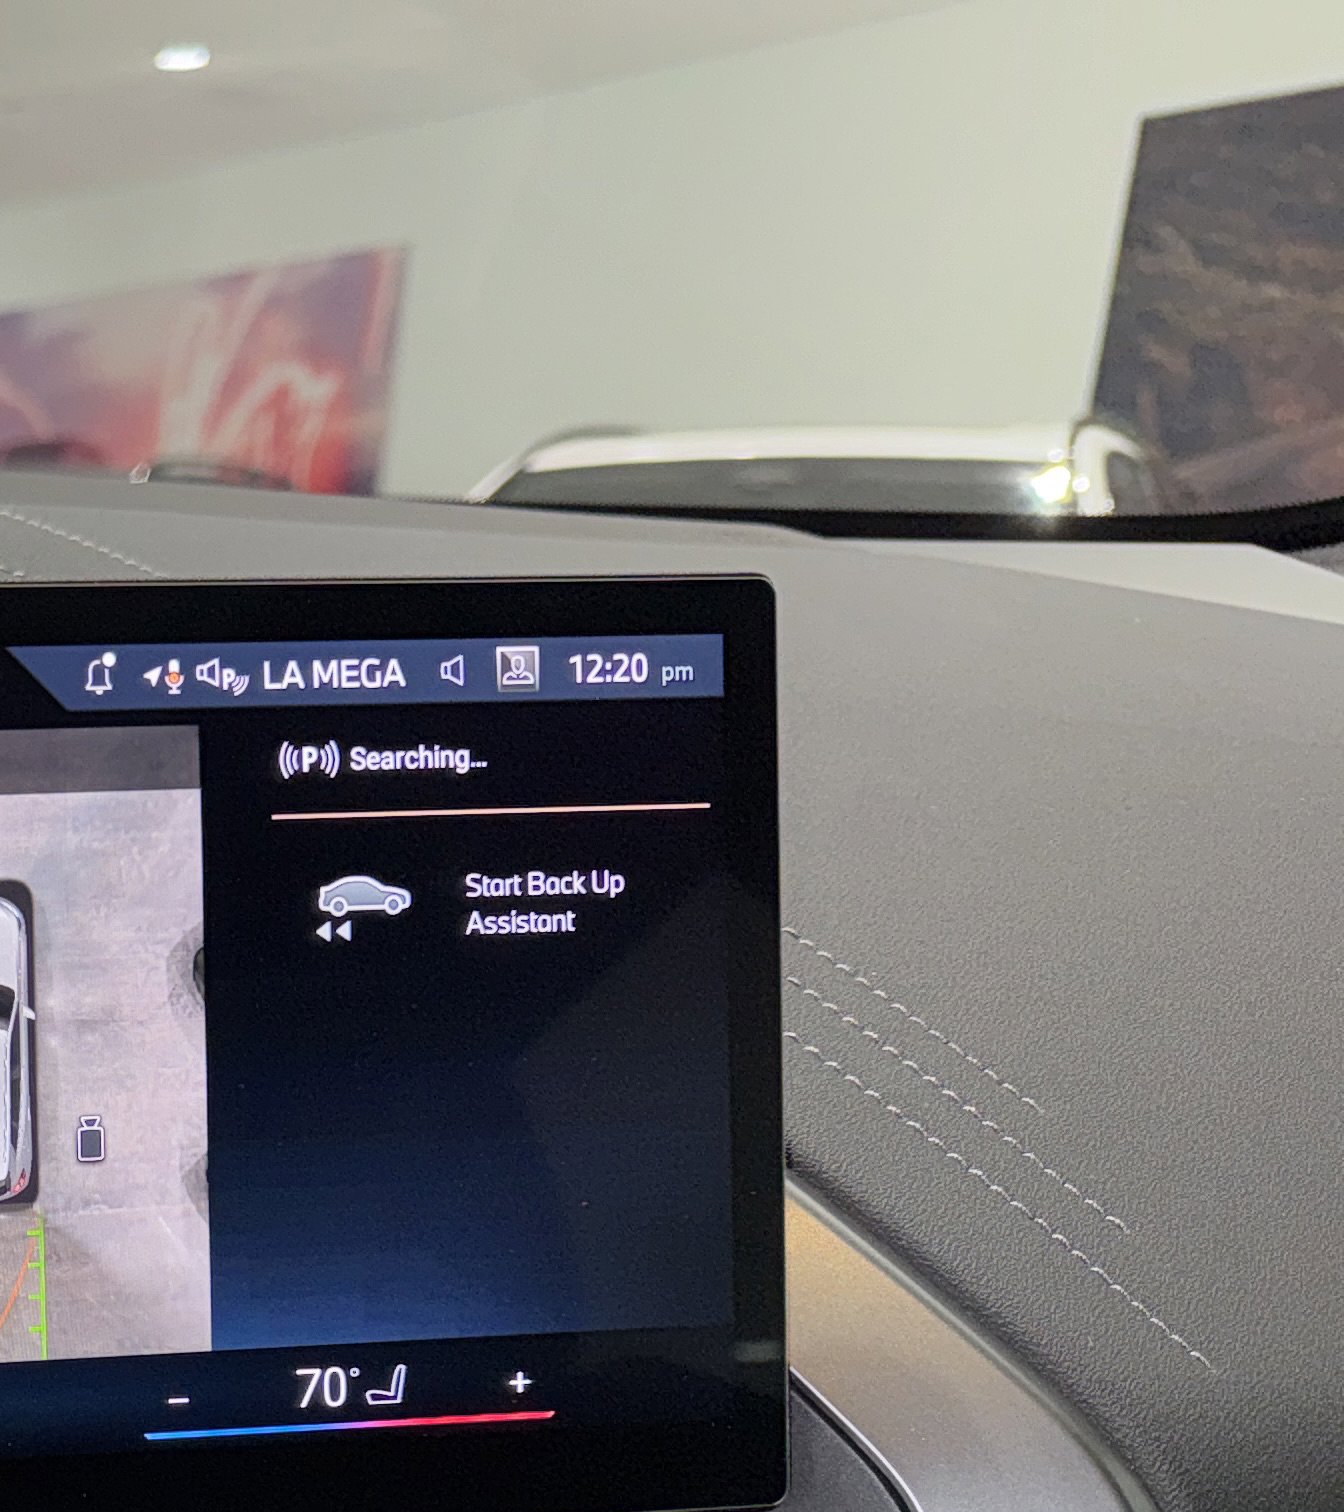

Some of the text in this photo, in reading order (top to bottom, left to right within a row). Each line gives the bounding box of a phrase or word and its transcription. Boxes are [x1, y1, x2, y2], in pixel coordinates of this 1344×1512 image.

[263, 657, 407, 690] LA MEGA
[568, 652, 695, 687] 12:20 pm
[349, 743, 489, 775] Searching...
[465, 869, 626, 899] Start Back Up
[465, 909, 577, 936] Assistant
